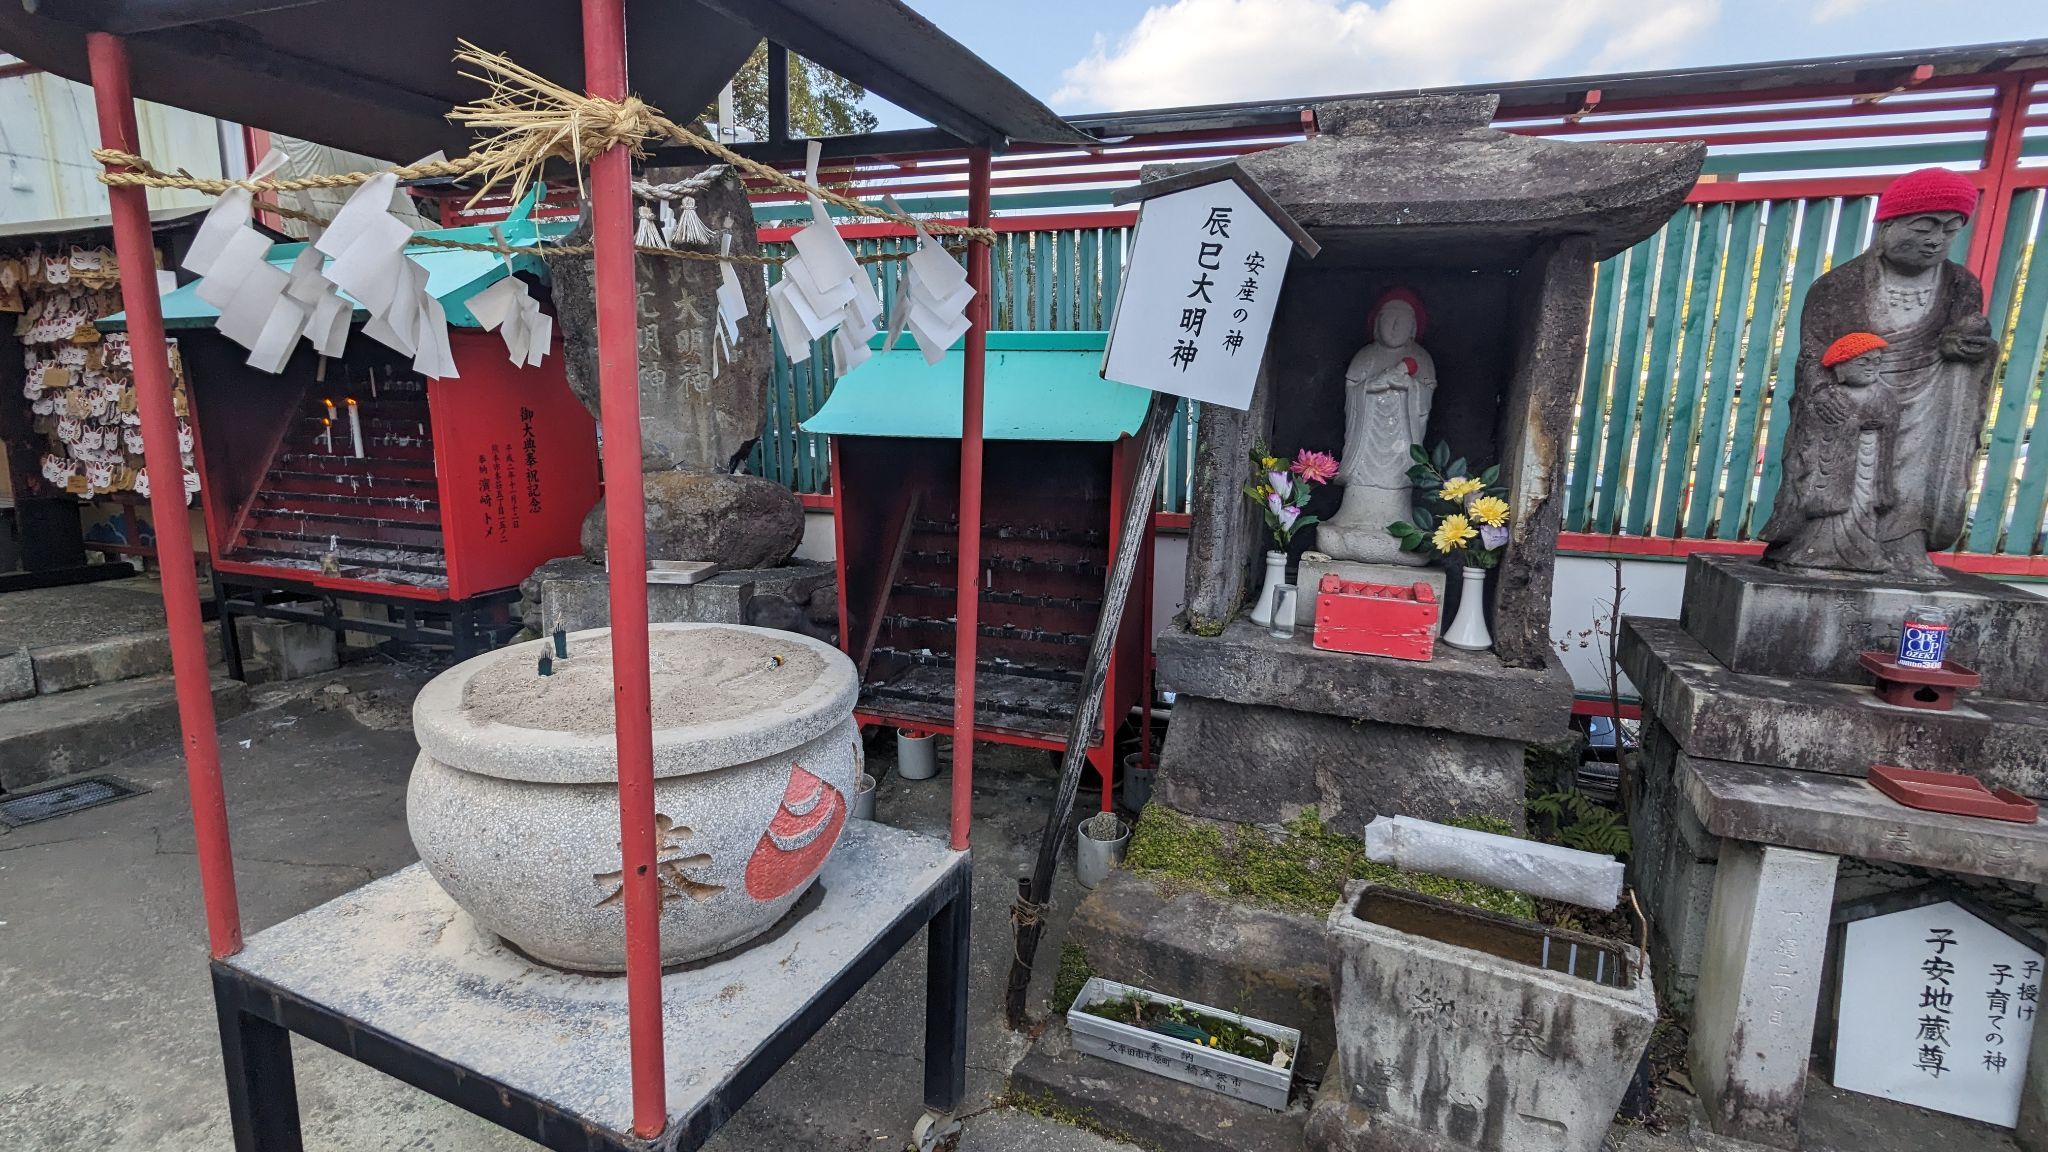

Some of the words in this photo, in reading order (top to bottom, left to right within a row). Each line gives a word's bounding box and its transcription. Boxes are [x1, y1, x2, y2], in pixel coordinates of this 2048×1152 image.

[1169, 207, 1233, 373] 辰巳大明神
[1222, 251, 1265, 356] 安産の神
[1906, 628, 1938, 641] One
[1906, 651, 1935, 659] OZEKI
[1913, 928, 1958, 1078] 子安地蔵尊
[1982, 964, 2014, 1073] 子育ての神
[2017, 960, 2041, 1021] 子授け
